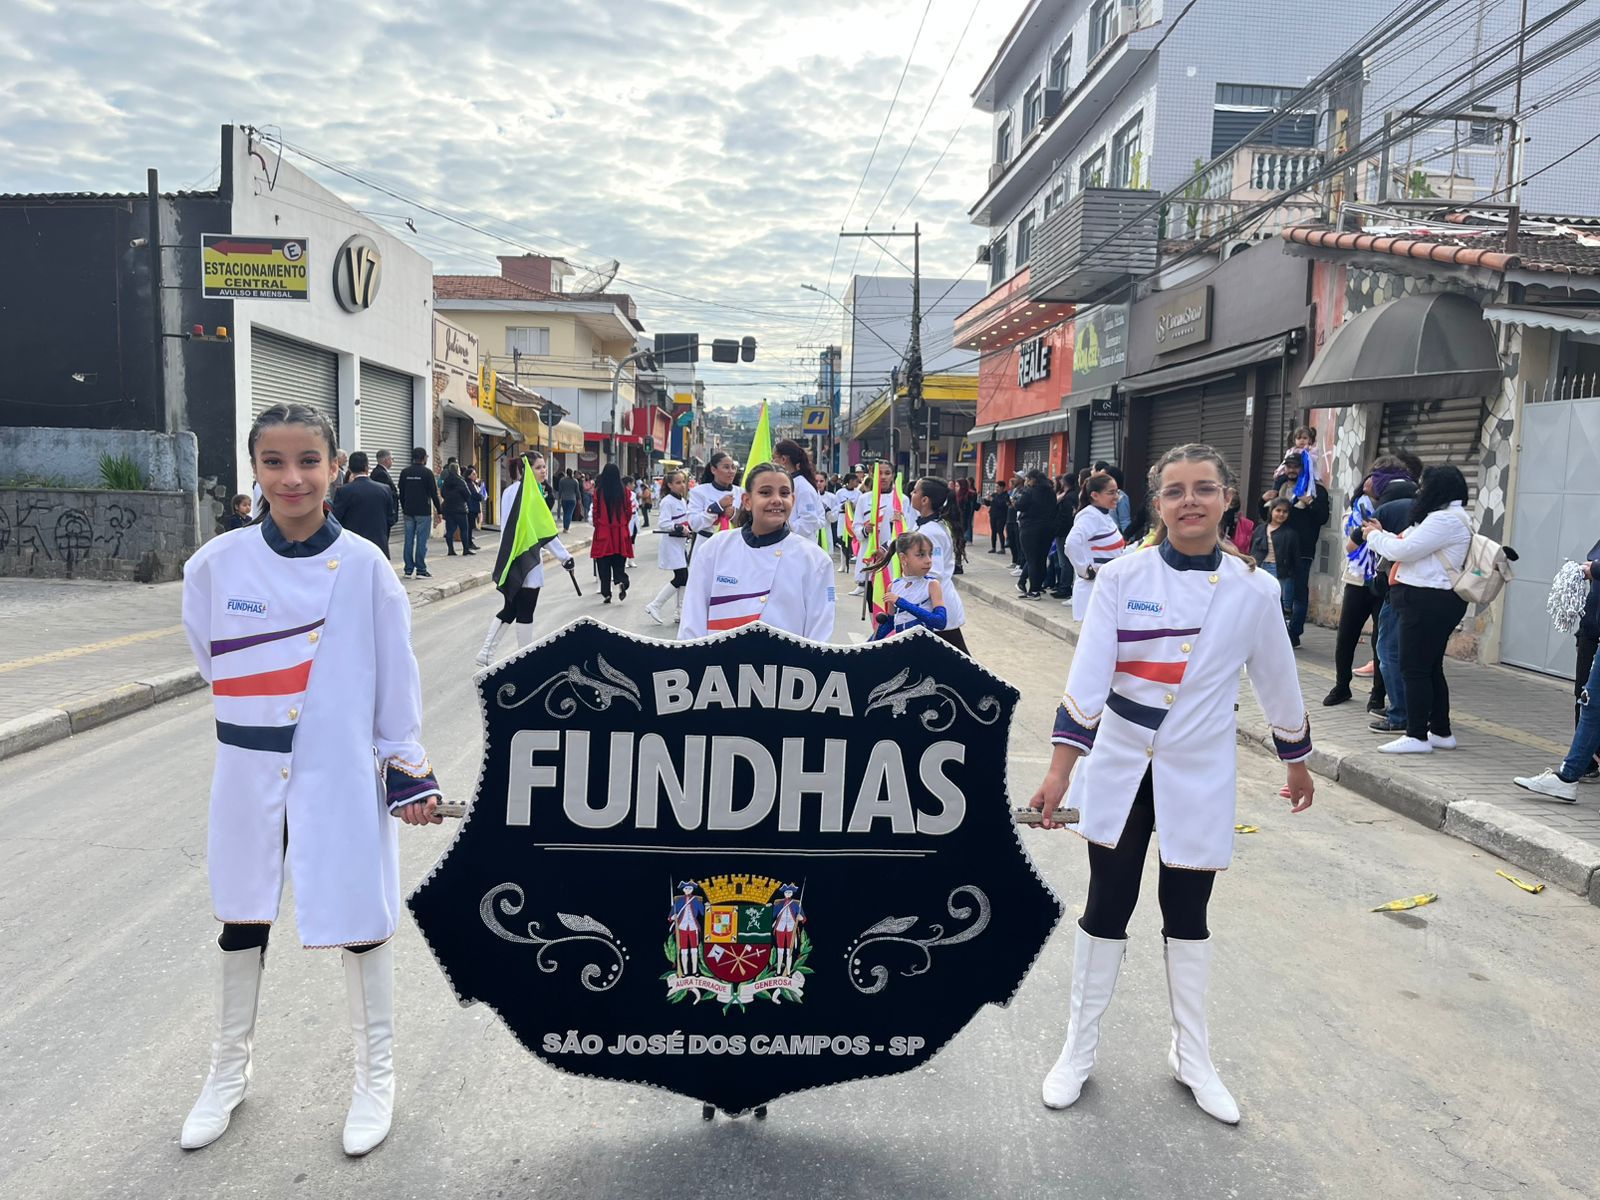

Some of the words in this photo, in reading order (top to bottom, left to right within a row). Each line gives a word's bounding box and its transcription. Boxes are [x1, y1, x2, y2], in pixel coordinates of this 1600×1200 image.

[204, 261, 306, 278] ESTACIONAMENTO
[346, 246, 382, 308] V7
[224, 278, 287, 289] CENTRAL
[219, 288, 251, 297] AVULSO
[252, 289, 258, 297] E
[259, 290, 293, 298] MENSAL
[1018, 336, 1050, 388] REALE
[227, 600, 262, 613] FUNDHAS
[1127, 601, 1159, 612] FUNDHAS
[652, 664, 854, 717] BANDA
[505, 729, 966, 835] FUNDHAS
[675, 979, 694, 987] AURA
[695, 980, 728, 993] TERRAQUE
[754, 979, 793, 990] GENEROSA
[542, 1029, 604, 1055] SÃO
[608, 1030, 685, 1055] JOSÉ
[688, 1034, 747, 1056] DOS
[749, 1034, 870, 1056] CAMPOS
[888, 1035, 926, 1056] SP
